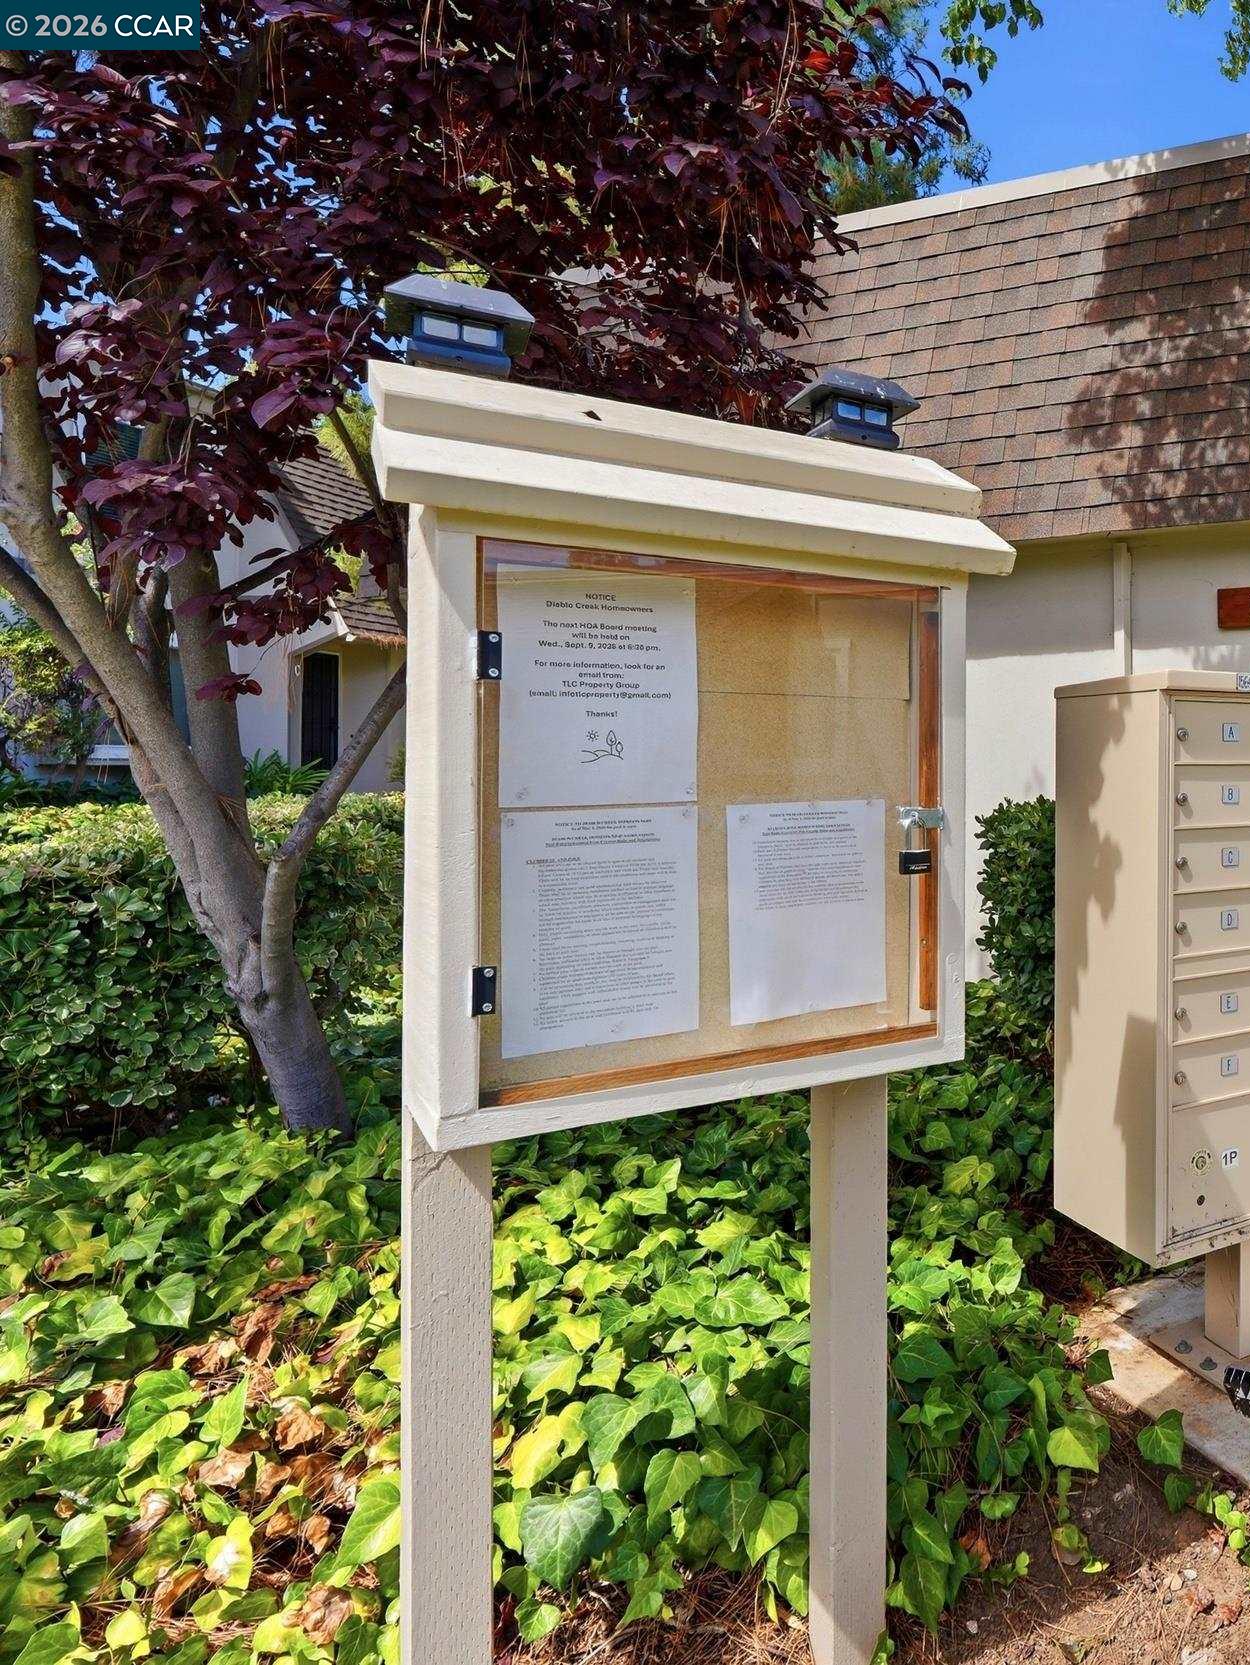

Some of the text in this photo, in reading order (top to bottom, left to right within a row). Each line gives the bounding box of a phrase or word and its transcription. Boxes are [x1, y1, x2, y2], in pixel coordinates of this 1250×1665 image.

[601, 604, 653, 613] Homeowners
[543, 620, 558, 628] The
[625, 625, 657, 633] meeting
[573, 661, 623, 670] information,
[580, 681, 614, 689] Property
[1228, 726, 1235, 739] A
[1228, 850, 1233, 864] C
[1226, 995, 1231, 1009] E
[1226, 1058, 1232, 1071] F
[1222, 1150, 1238, 1166] 1P
